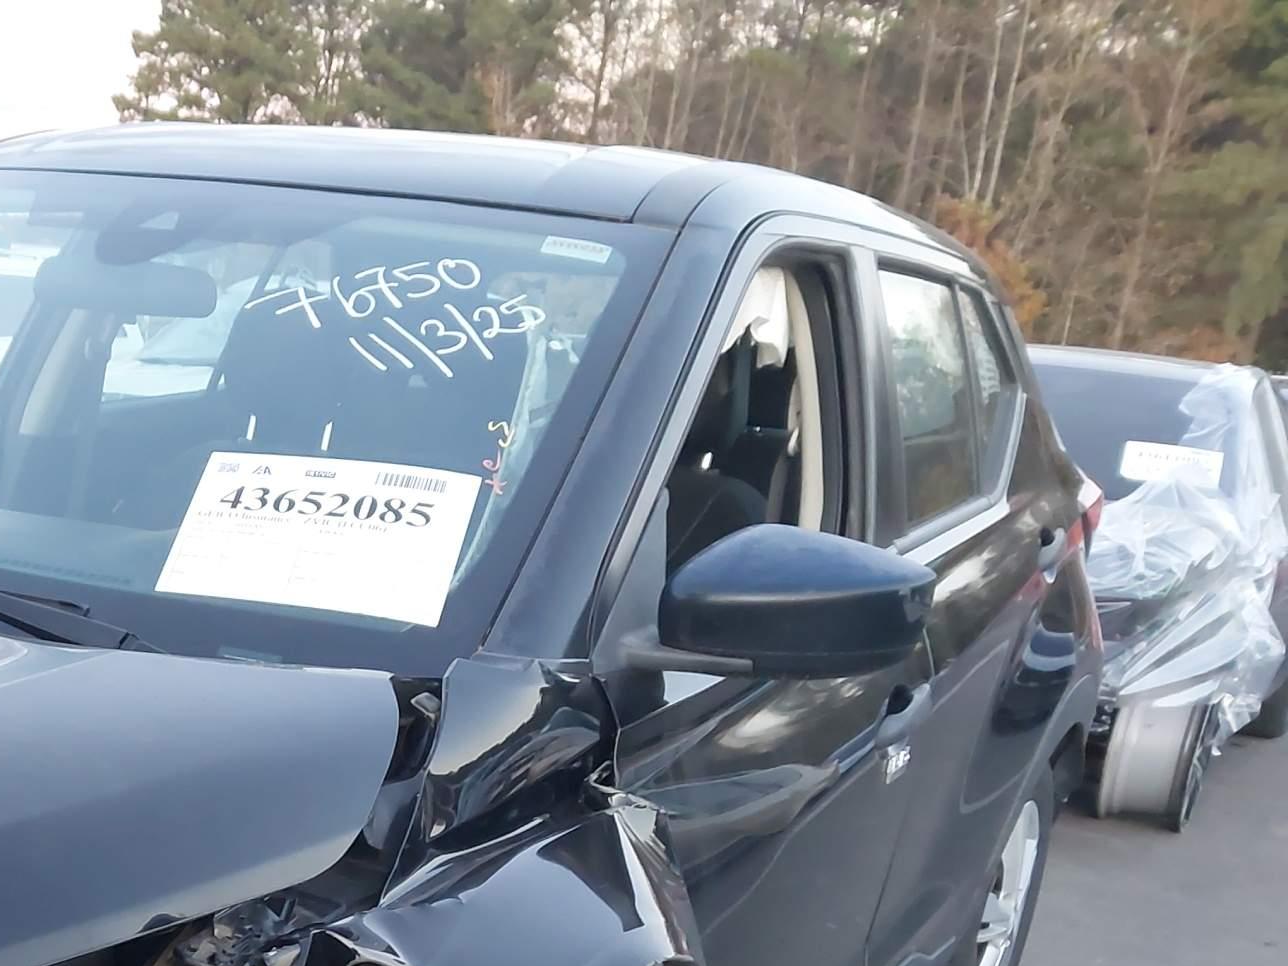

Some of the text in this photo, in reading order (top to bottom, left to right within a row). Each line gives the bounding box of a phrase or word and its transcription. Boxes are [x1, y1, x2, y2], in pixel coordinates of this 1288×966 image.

[244, 258, 481, 329] 76750
[349, 294, 546, 378] 11/3/25
[220, 485, 436, 527] 43652085
